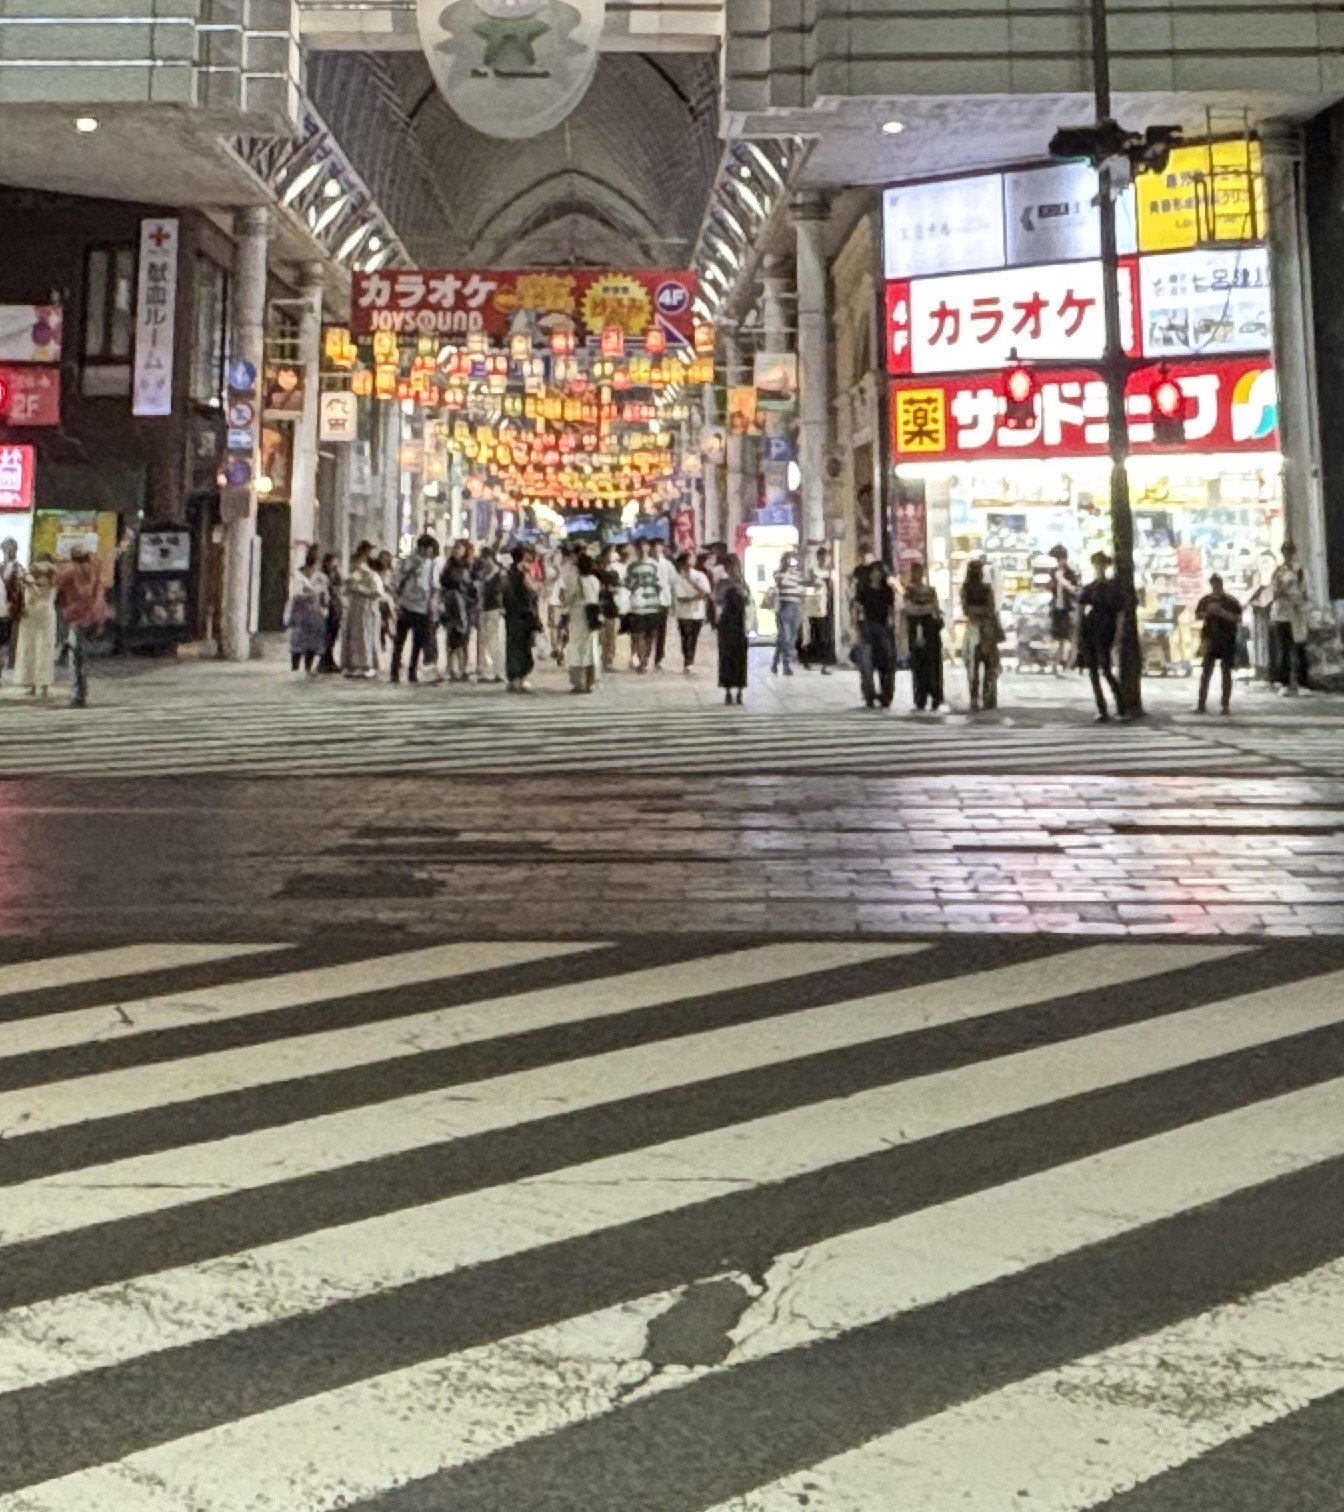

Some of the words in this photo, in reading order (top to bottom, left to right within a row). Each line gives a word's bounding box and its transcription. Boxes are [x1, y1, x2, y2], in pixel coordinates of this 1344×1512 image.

[357, 273, 498, 309] カラオケ
[657, 288, 686, 307] 4F
[369, 310, 484, 332] JOYSOUND
[926, 288, 1097, 347] カラオケ
[901, 395, 941, 446] 薬
